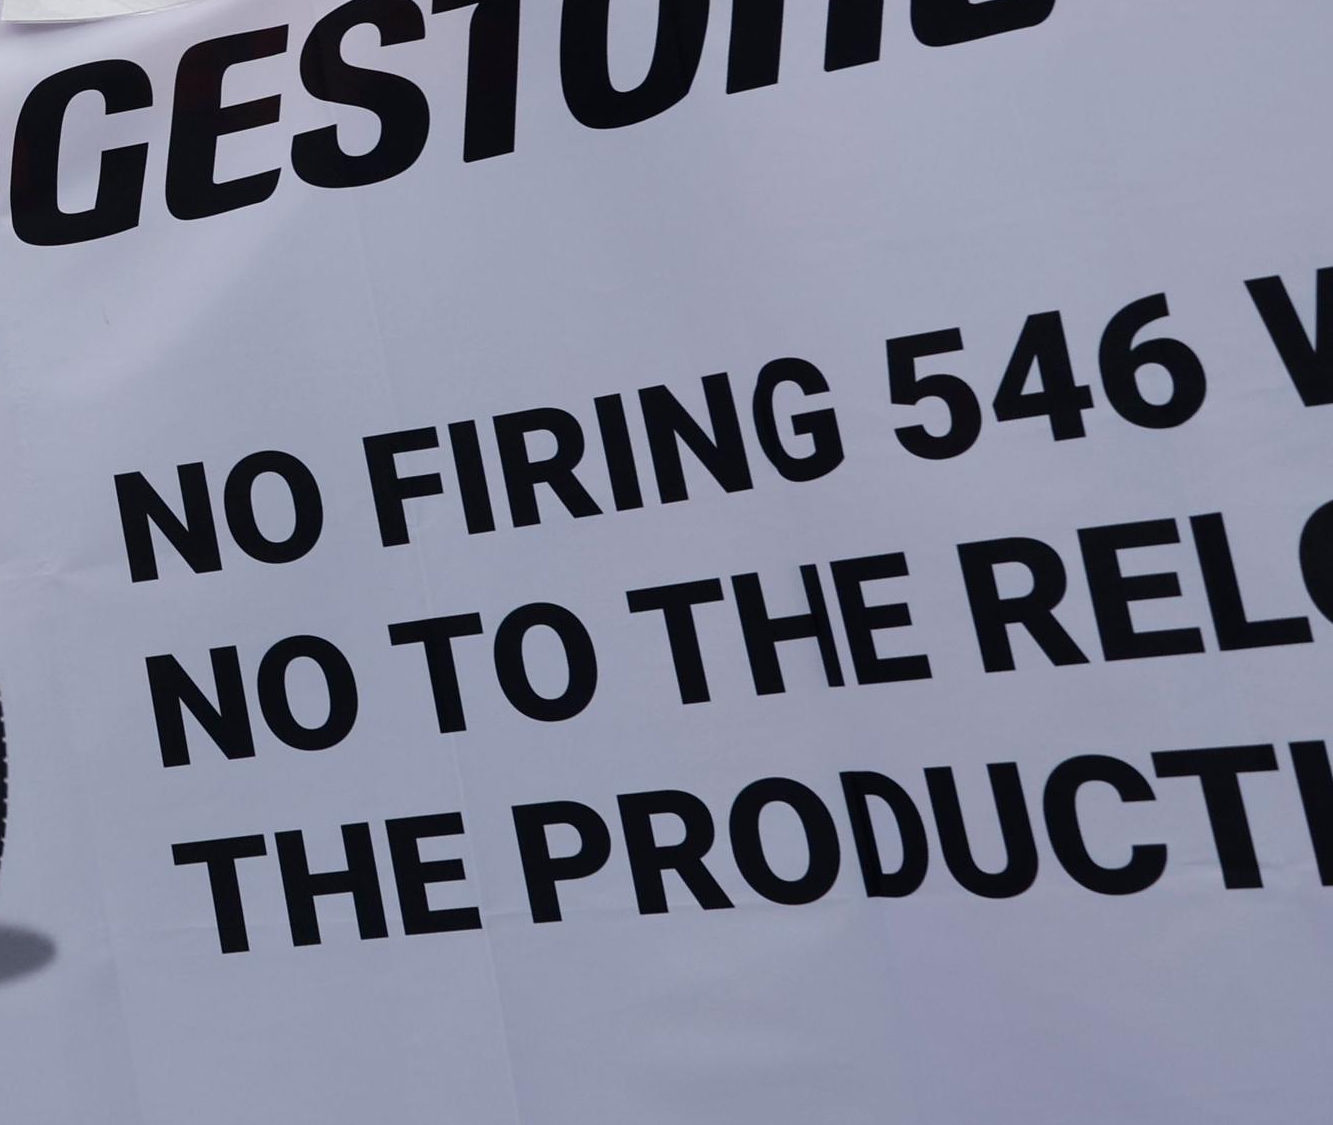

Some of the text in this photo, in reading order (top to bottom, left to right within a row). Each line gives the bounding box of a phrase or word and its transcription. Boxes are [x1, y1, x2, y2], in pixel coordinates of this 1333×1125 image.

[114, 450, 324, 583] NO
[362, 357, 845, 548] FIRING
[886, 292, 1207, 460] 546
[145, 634, 359, 768] NO
[388, 602, 598, 734] TO
[626, 551, 933, 705] THE
[171, 811, 483, 954] THE
